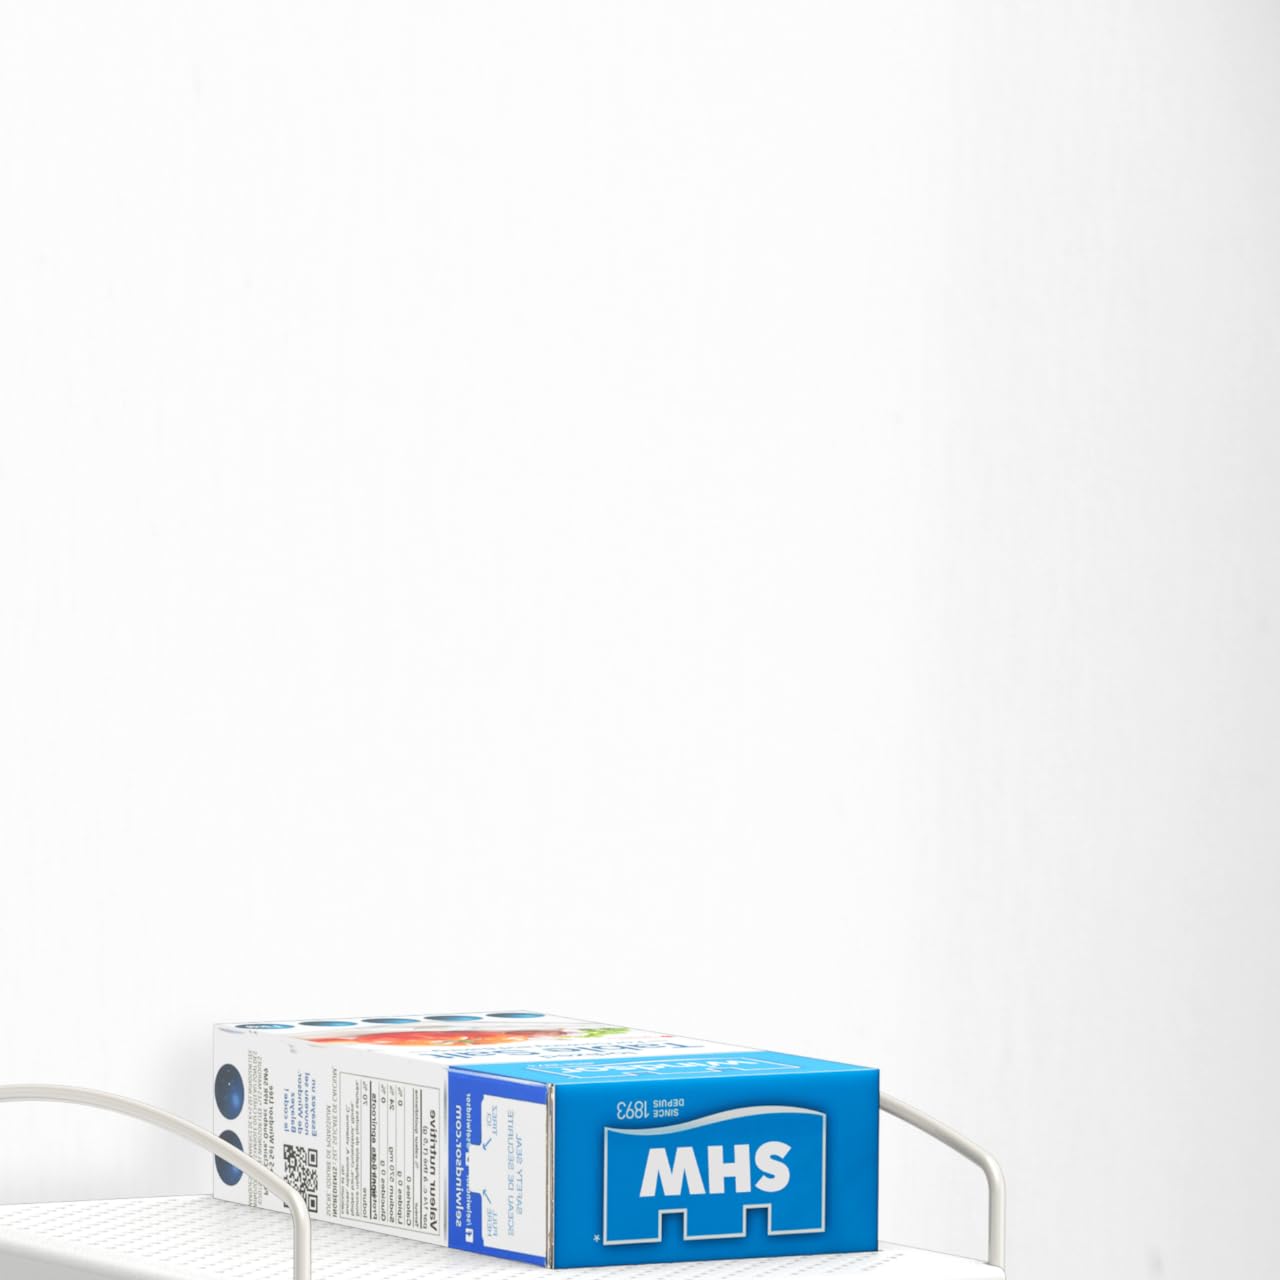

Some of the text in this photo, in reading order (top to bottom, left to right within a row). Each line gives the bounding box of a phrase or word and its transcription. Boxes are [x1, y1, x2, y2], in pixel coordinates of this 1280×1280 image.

[653, 1098, 685, 1108] DEPUIS
[616, 1101, 679, 1120] SINCE 1893
